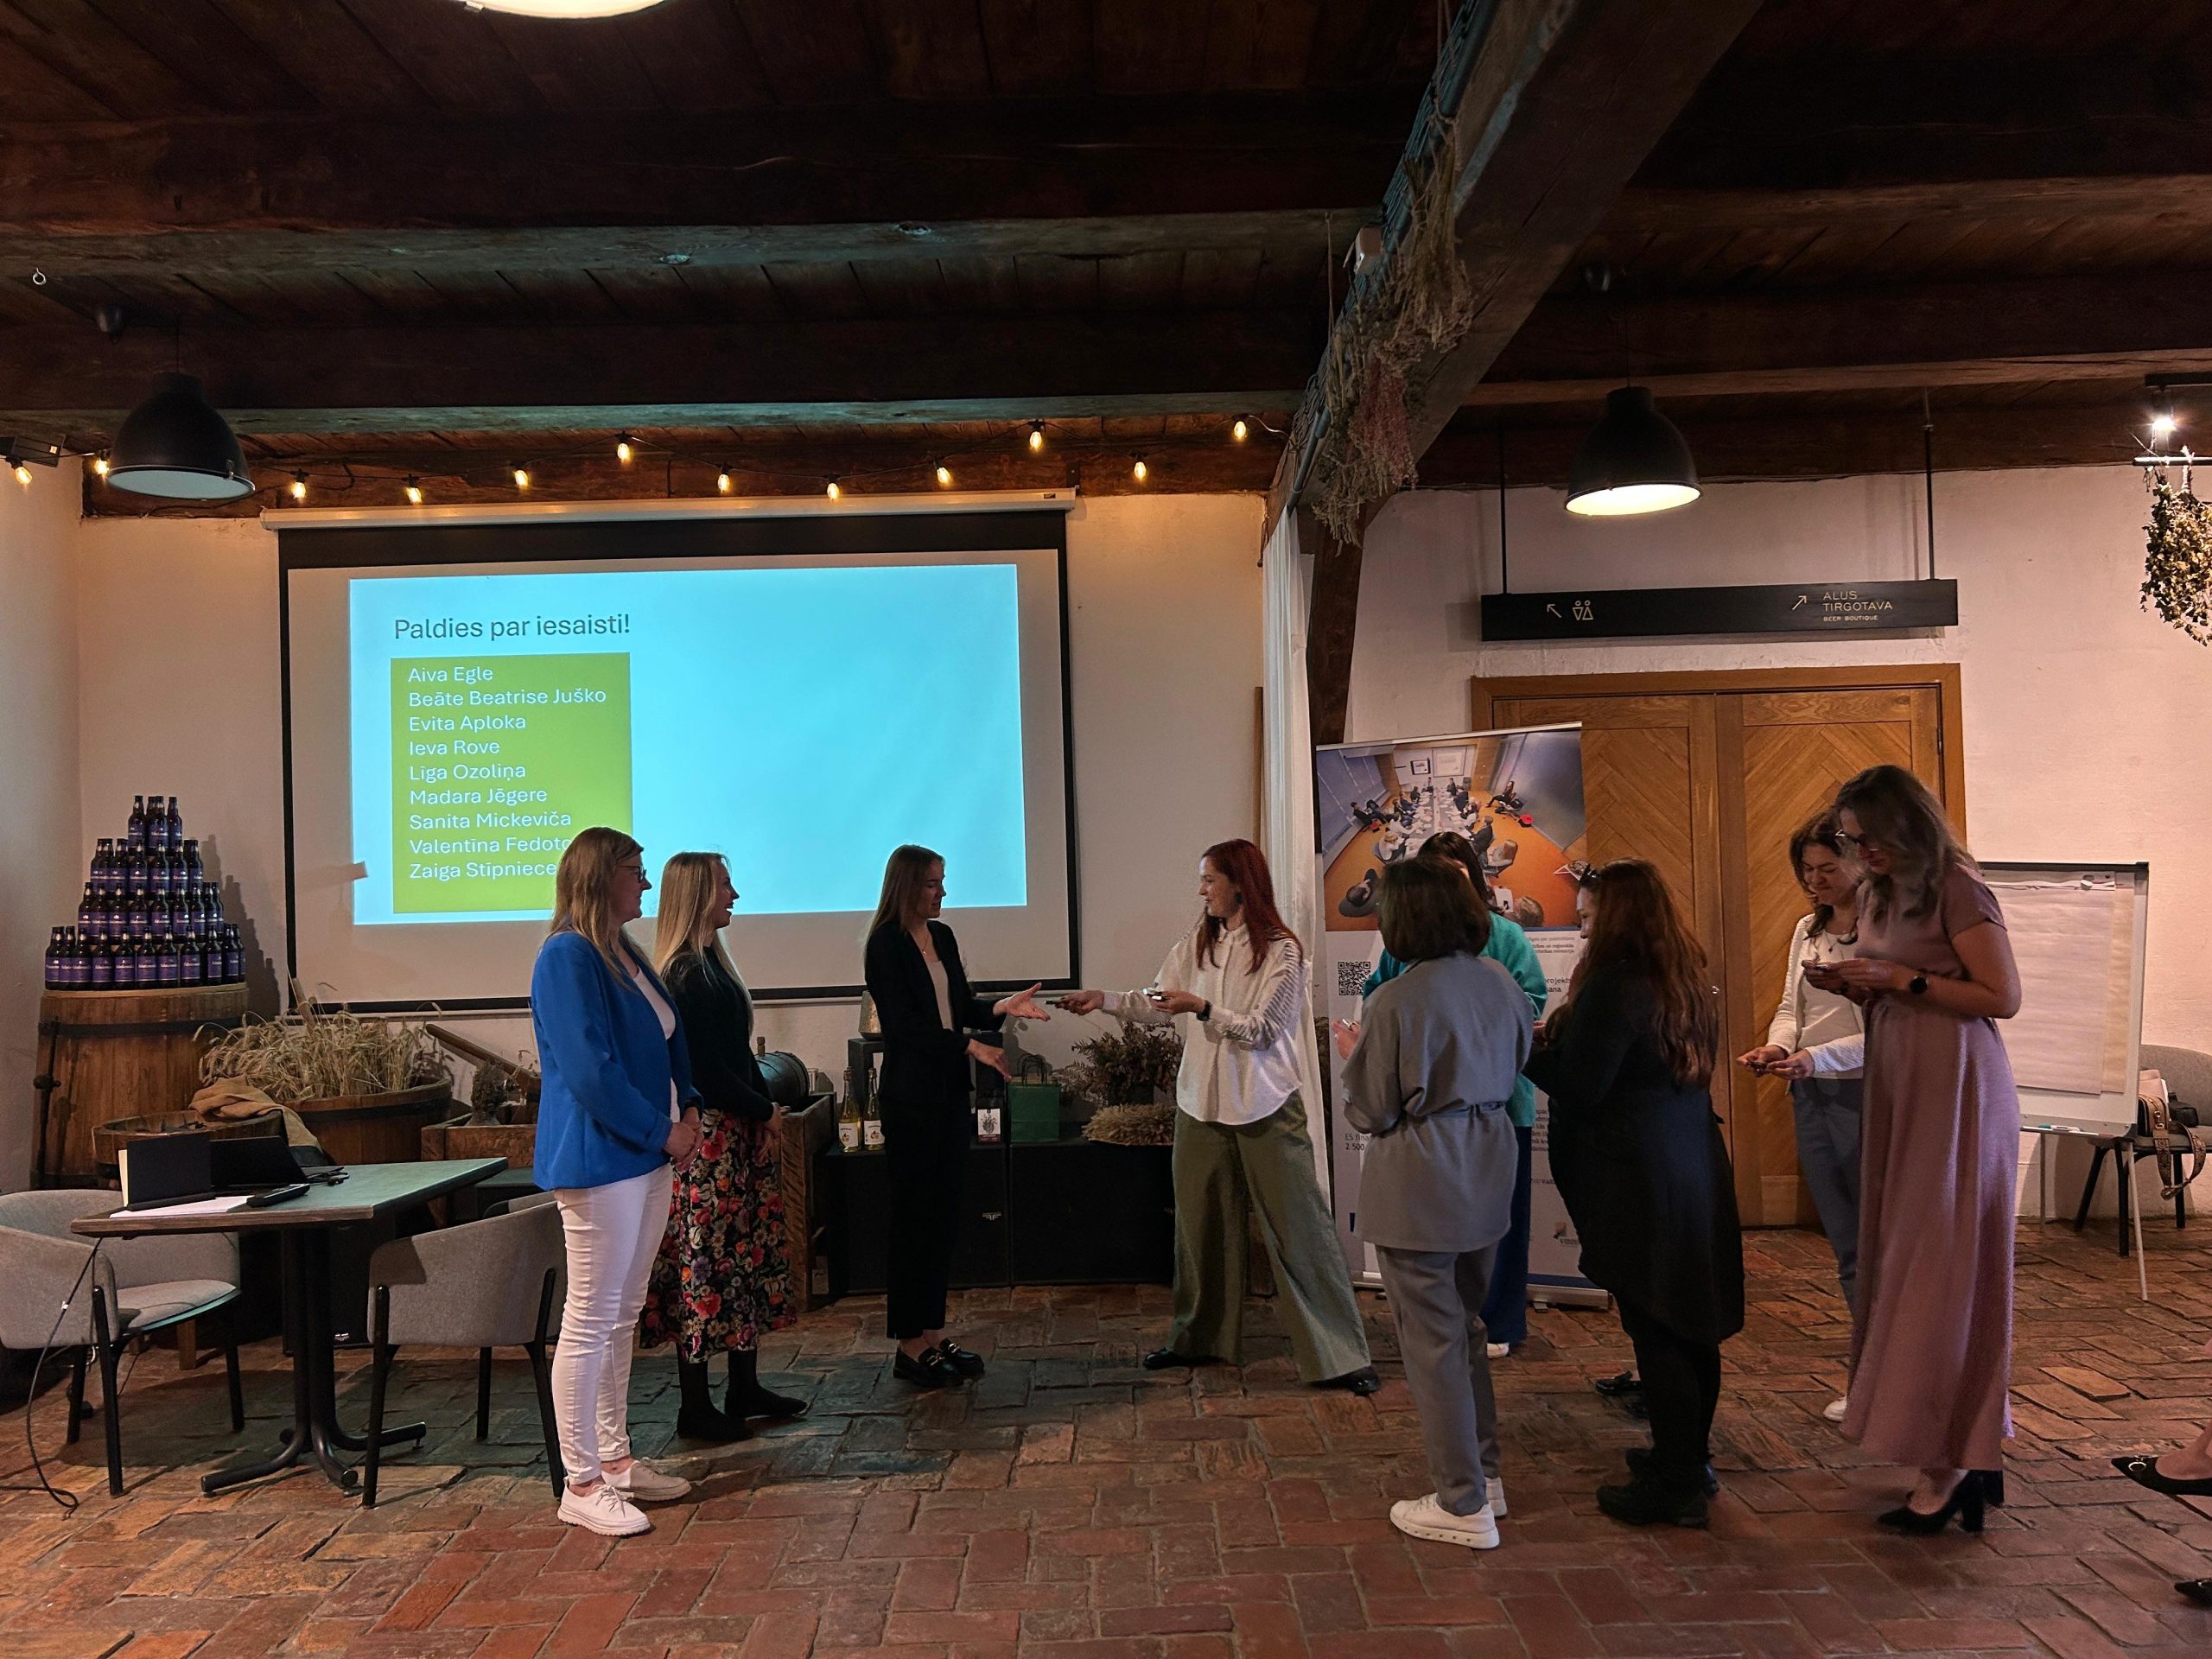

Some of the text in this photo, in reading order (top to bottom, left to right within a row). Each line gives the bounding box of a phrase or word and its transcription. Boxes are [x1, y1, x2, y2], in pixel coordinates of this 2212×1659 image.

[1823, 590, 1858, 600] ALUS
[1822, 601, 1893, 612] TIRGOTAVA
[394, 613, 631, 641] Paldies par iesaisti!
[408, 666, 494, 685] Aiva Egle
[409, 687, 607, 707] Beāte Beatrise Juško
[409, 714, 527, 734] Evita Aploka
[410, 740, 501, 757] Ieva Rove
[410, 763, 527, 784] Līga Ozoliņa
[410, 787, 549, 806] Madara Jēgere
[410, 810, 572, 830] Sanita Mickeviča
[410, 836, 572, 855] Valentīna Fedoto
[410, 860, 557, 882] Zaiga Stīpniece
[1344, 1133, 1370, 1141] ES fina
